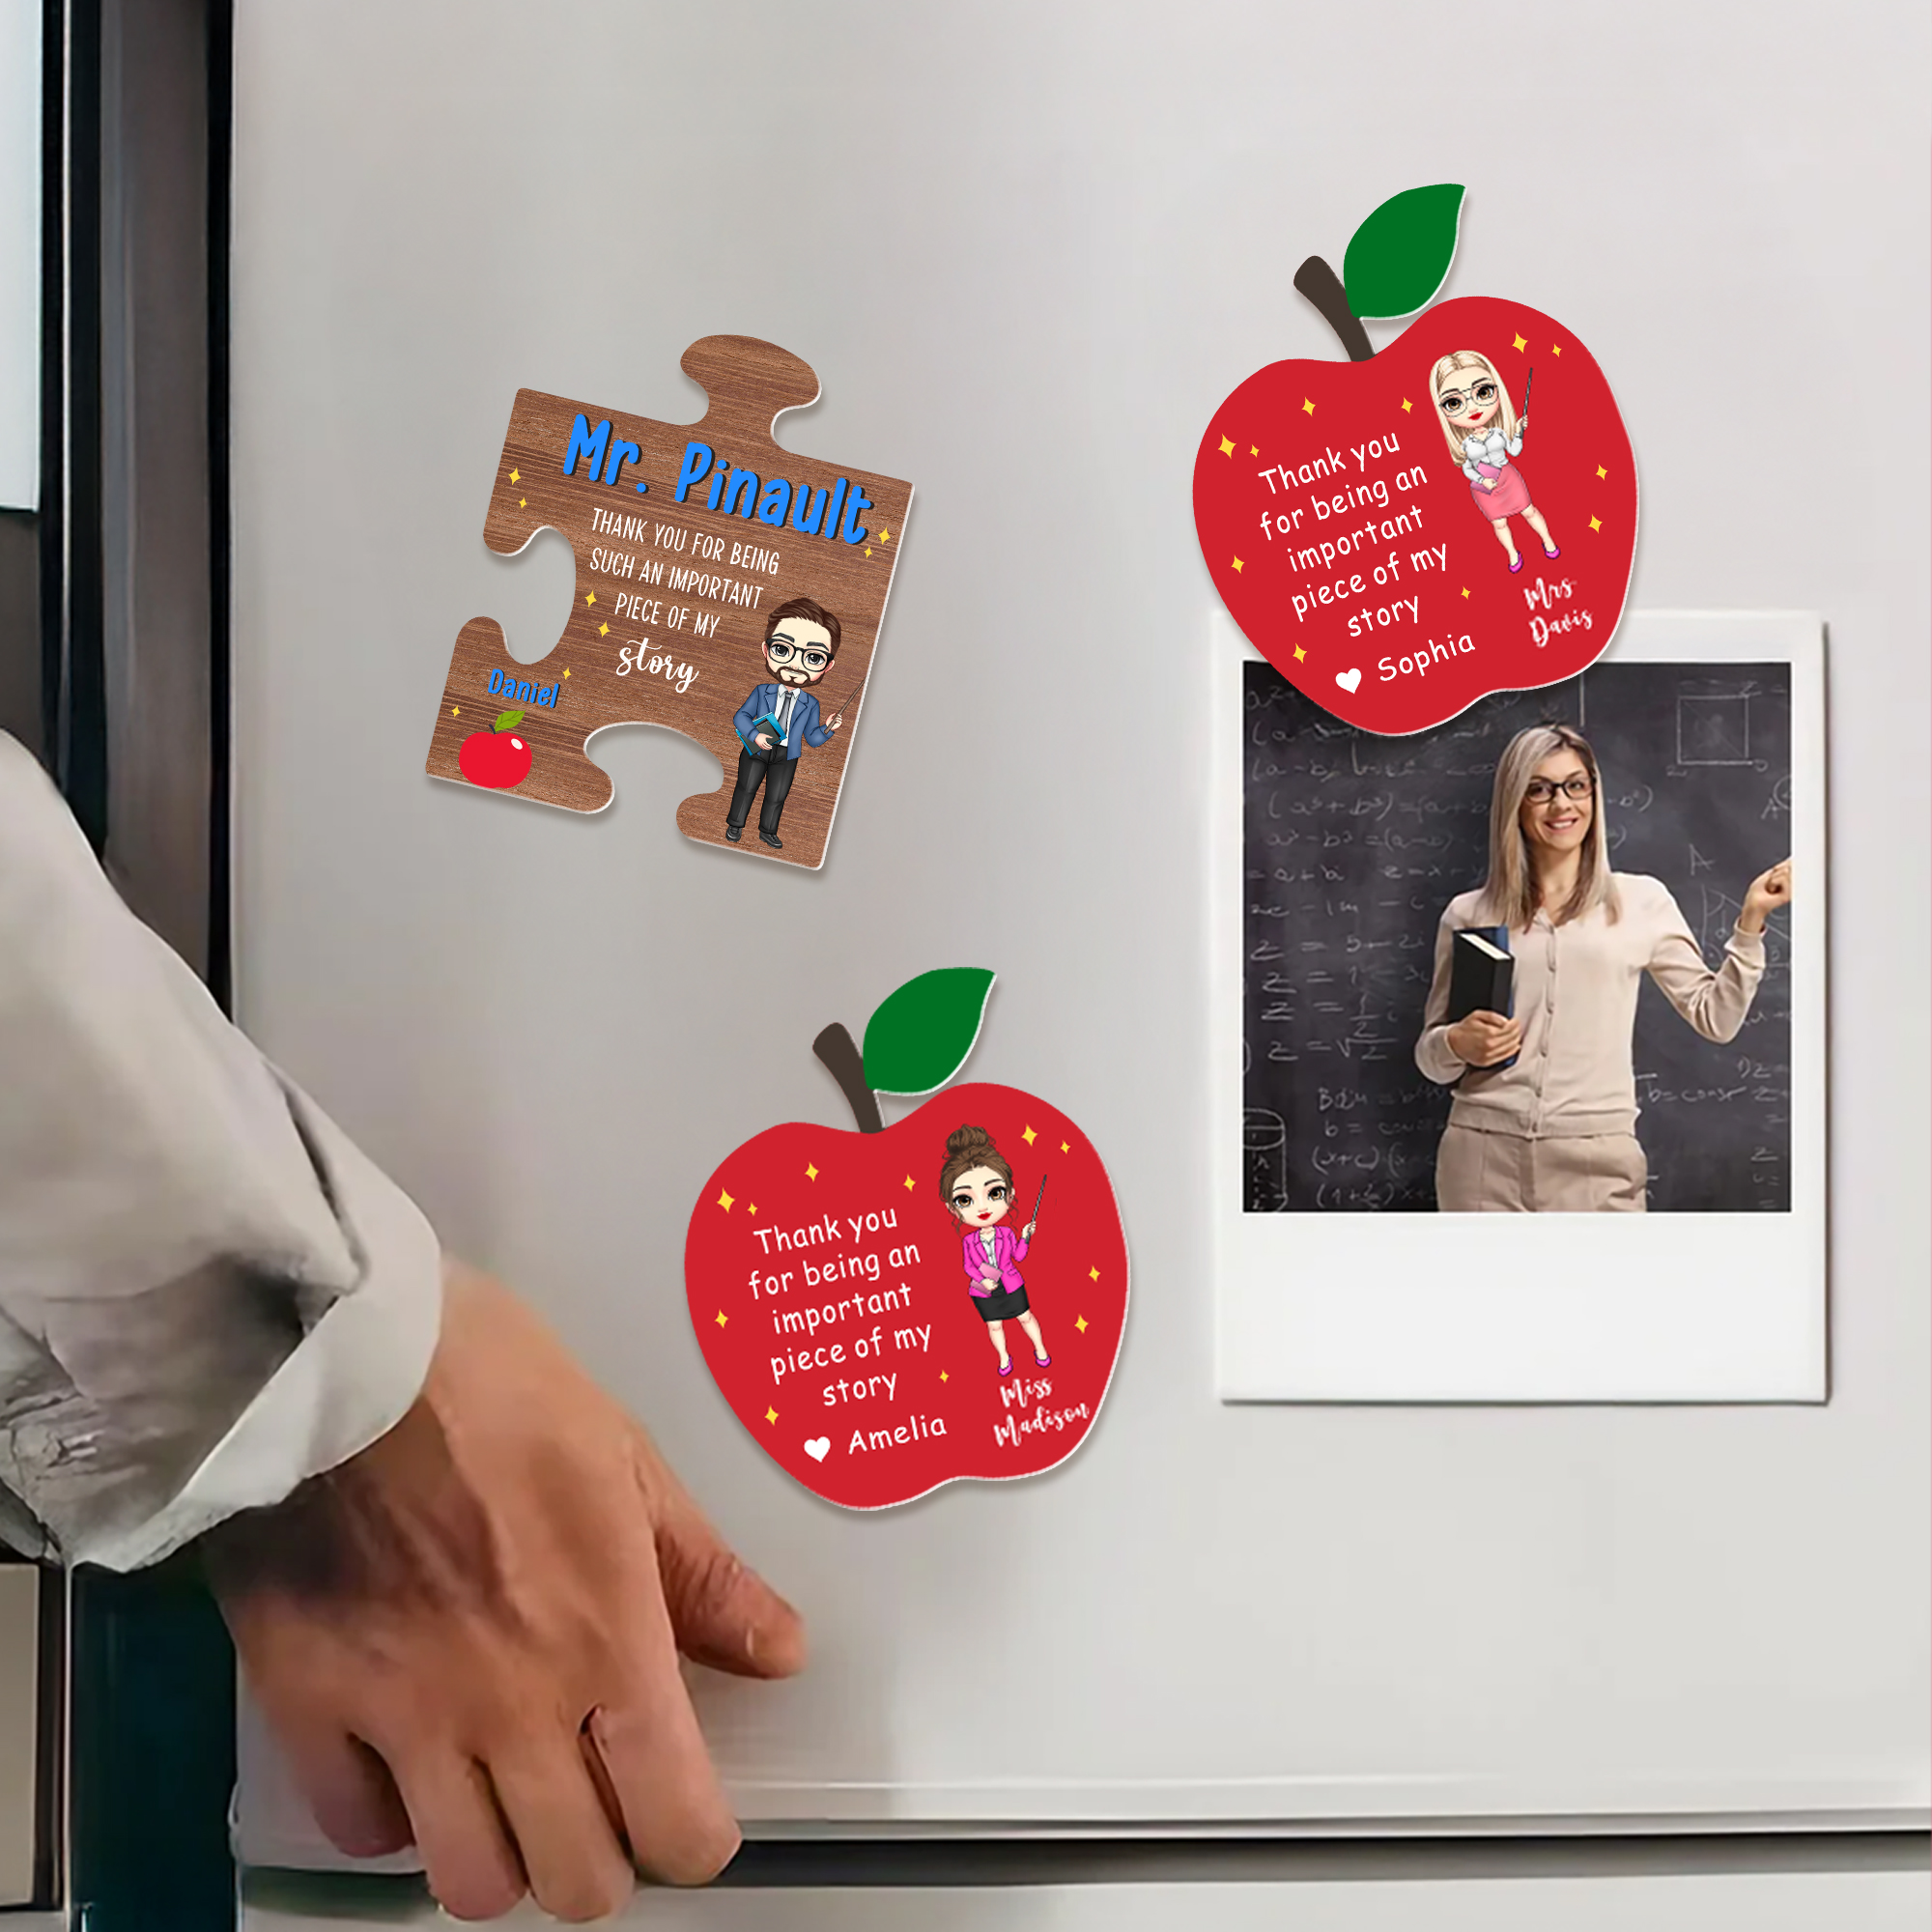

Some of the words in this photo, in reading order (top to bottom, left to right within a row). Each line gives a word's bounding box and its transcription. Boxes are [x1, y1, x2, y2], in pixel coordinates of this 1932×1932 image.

[562, 413, 648, 495] Mr.
[674, 441, 874, 545] Pinault
[1257, 446, 1347, 495] Thank
[1350, 432, 1401, 472] you
[1260, 508, 1304, 541] for
[1310, 480, 1389, 521] being
[1395, 466, 1428, 492] an
[591, 507, 648, 544] THANK
[654, 523, 688, 553] YOU
[691, 532, 725, 562] FOR
[729, 541, 781, 576] BEING
[1287, 504, 1423, 573] important
[589, 547, 636, 579] SUCH
[638, 559, 665, 586] AN
[668, 565, 765, 610] IMPORTANT
[1291, 574, 1367, 623] piece
[1373, 551, 1400, 585] of
[1409, 543, 1446, 573] my
[1523, 577, 1573, 611] Mrs
[614, 591, 664, 625] PIECE
[667, 605, 691, 631] OF
[693, 611, 721, 639] MY
[1348, 595, 1419, 638] story
[1528, 610, 1593, 647] Davis
[615, 637, 700, 695] story
[1378, 632, 1476, 682] Sophia
[487, 668, 559, 709] Daniel
[753, 1213, 842, 1255] Thank
[847, 1208, 897, 1244] you
[748, 1269, 794, 1300] for
[802, 1254, 880, 1287] being
[889, 1244, 921, 1268] an
[772, 1282, 912, 1336] important
[770, 1344, 846, 1385] piece
[854, 1325, 883, 1358] of
[894, 1323, 931, 1352] my
[822, 1373, 897, 1406] story
[1000, 1378, 1052, 1408] Miss
[848, 1414, 948, 1455] Amelia
[993, 1403, 1088, 1447] Madison
